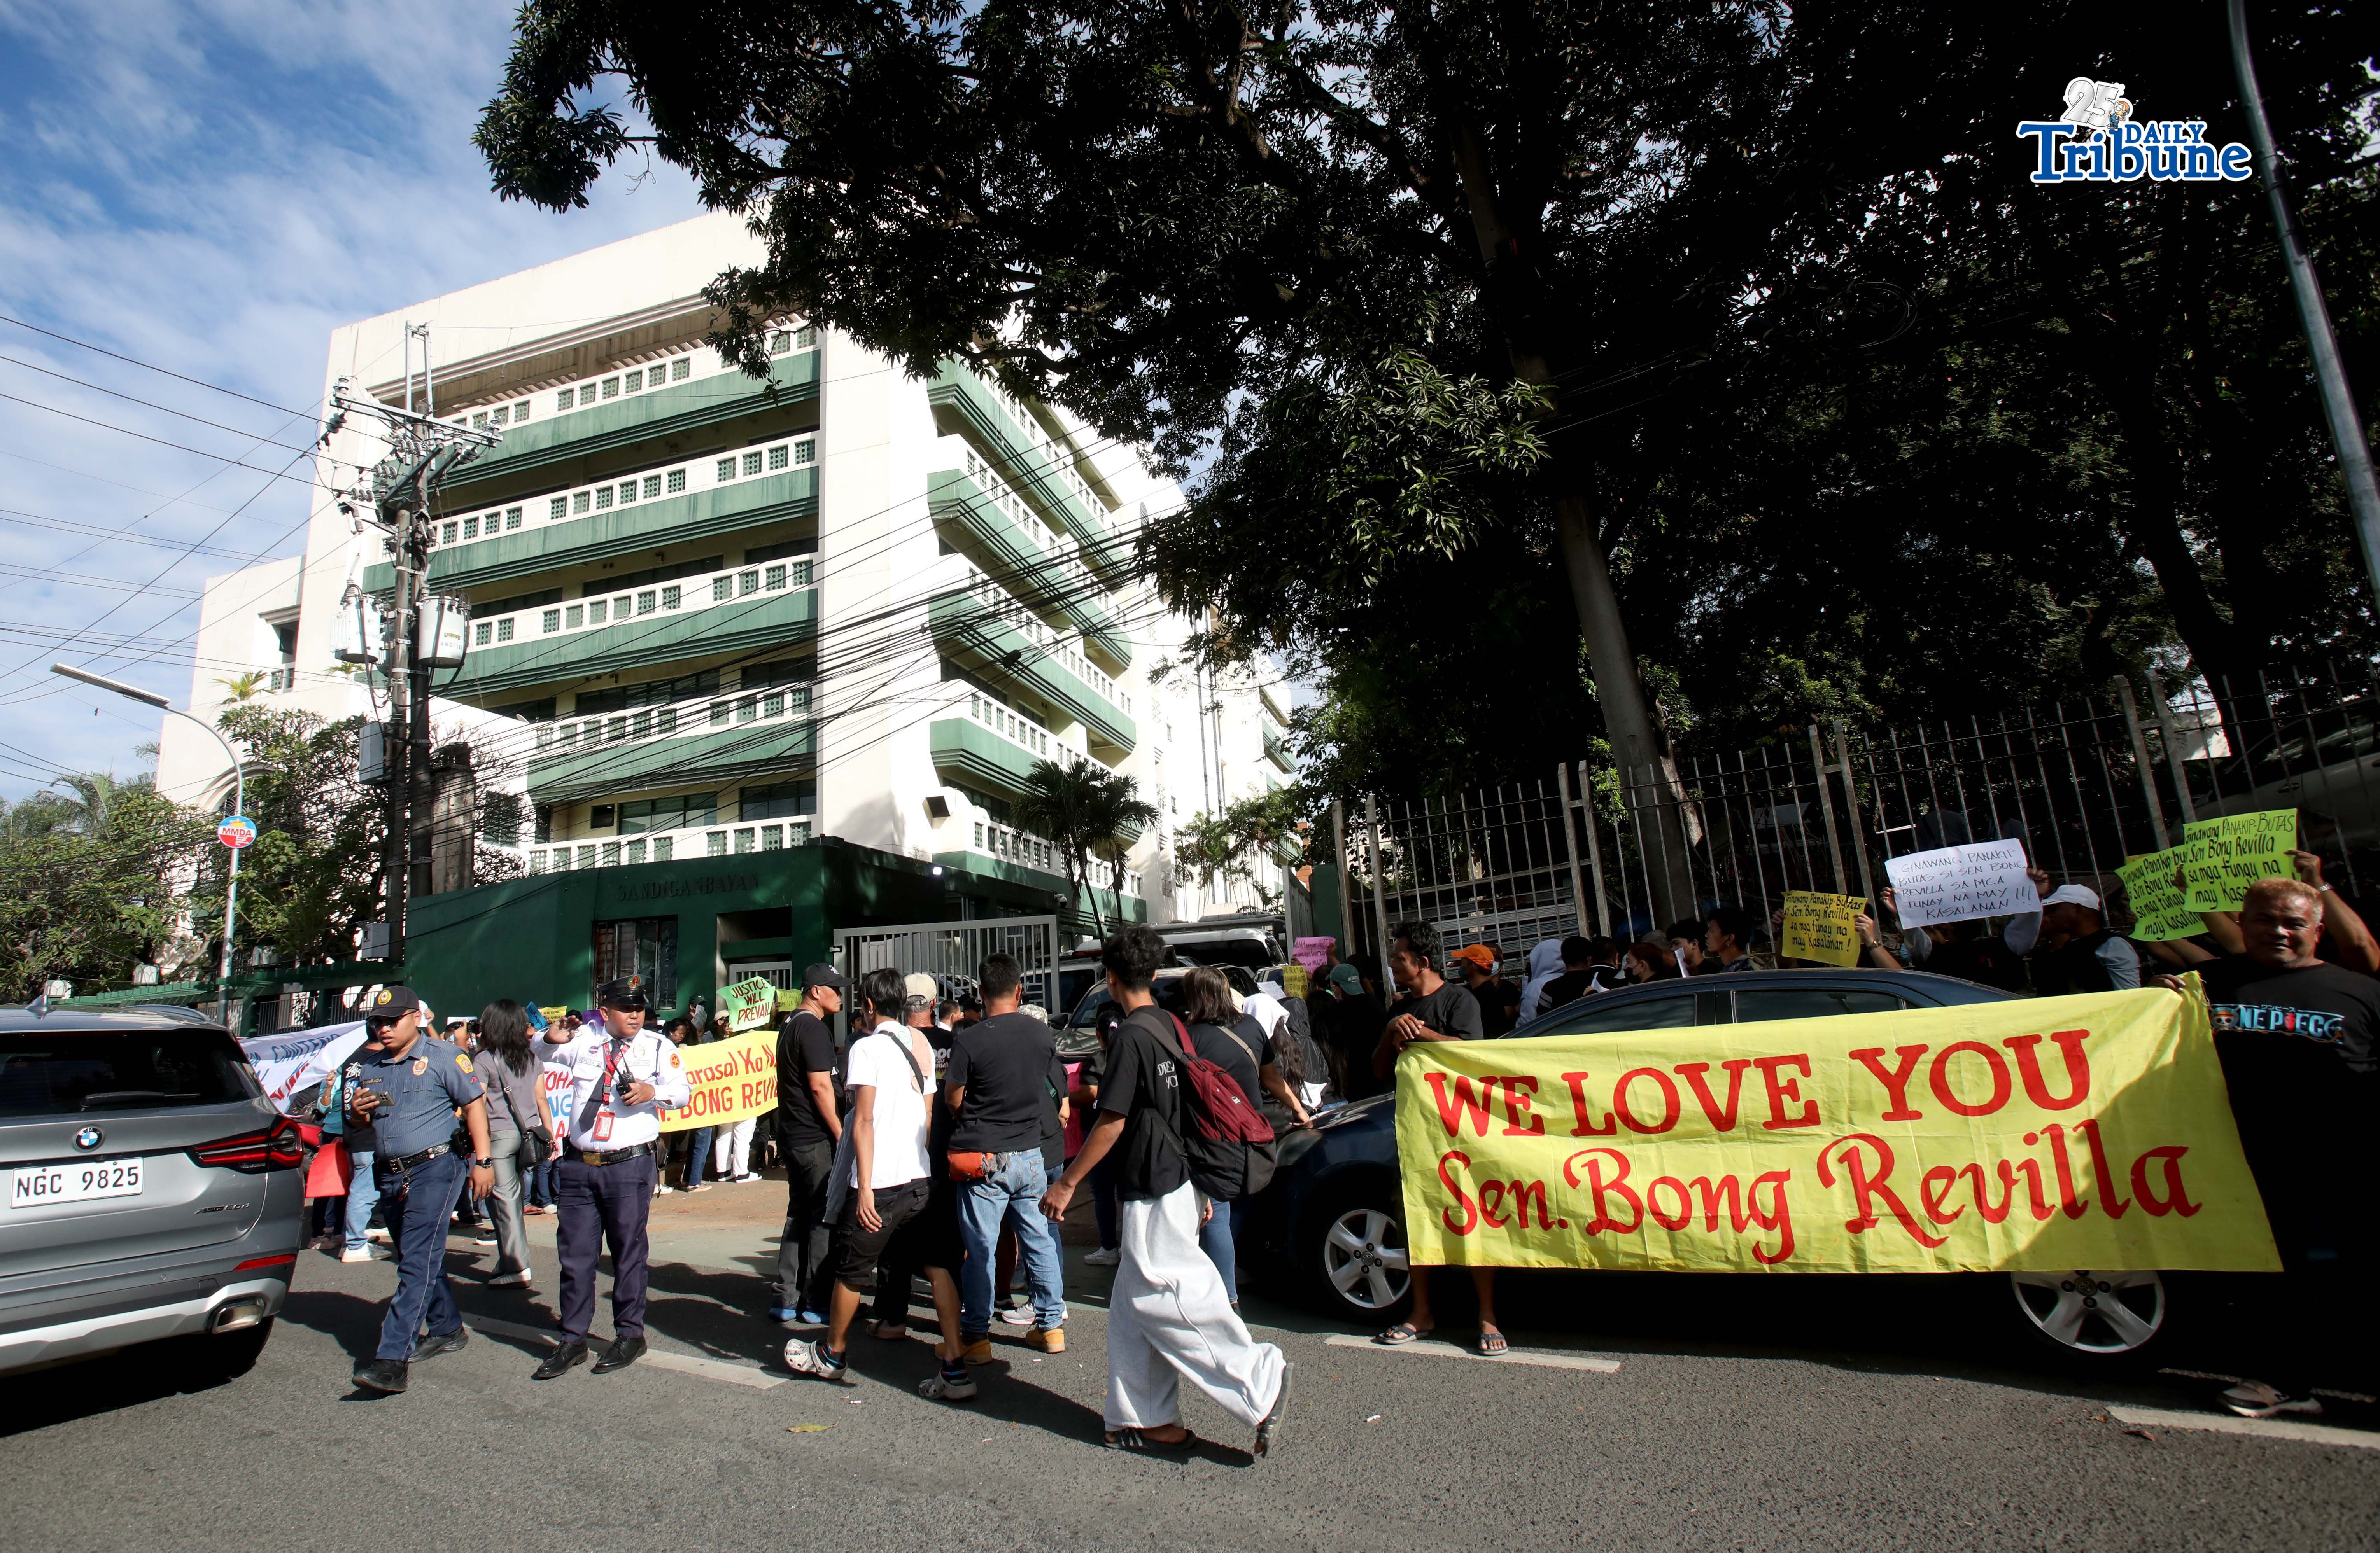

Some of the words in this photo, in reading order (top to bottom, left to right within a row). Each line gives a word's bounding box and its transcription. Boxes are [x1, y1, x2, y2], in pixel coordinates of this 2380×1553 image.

[222, 827, 252, 836] MMDA
[2185, 825, 2219, 844] Ginawang
[2222, 813, 2295, 836] PANAKIP-BUTAS
[2189, 844, 2204, 863] Sen
[2208, 839, 2232, 863] Bong
[2236, 834, 2275, 856] Revilla
[1902, 857, 1961, 873] GINAWANG
[1967, 849, 2016, 863] PANAKIP
[2188, 869, 2199, 883] sa
[2198, 864, 2221, 884] mga
[2222, 856, 2259, 880] tunay
[2262, 859, 2281, 874] na
[1898, 874, 1934, 887] BUTAS
[1940, 870, 1953, 879] SI
[1990, 860, 2026, 872] BONG
[616, 872, 760, 901] SANDIGANBAYAN
[1901, 884, 1944, 897] REVILLA
[1951, 880, 1969, 890] SA
[1974, 875, 2005, 888] MGA
[2144, 877, 2165, 897] Bong
[1786, 893, 1808, 907] Ginawang
[1906, 897, 1942, 908] TUNAY
[1954, 892, 1969, 902] NA
[1977, 887, 2007, 899] MAY
[2195, 889, 2218, 910] may
[1784, 906, 1789, 915] si
[1805, 904, 1820, 921] Bong
[1823, 906, 1849, 921] Revilla
[1926, 898, 2009, 920] KASALANAN
[2135, 906, 2146, 918] sa
[2144, 900, 2160, 918] mga
[1790, 922, 1797, 930] sa
[1799, 923, 1810, 934] mga
[1812, 920, 1832, 937] tunay
[1837, 926, 1847, 936] na
[2144, 920, 2166, 940] may
[1792, 936, 1805, 951] may
[1808, 934, 1843, 951] Kasalanan
[732, 979, 769, 999] JUSTICE
[744, 991, 765, 1006] WILL
[737, 1002, 771, 1025] PREVAIL
[1425, 1072, 1544, 1137] WE
[1561, 1054, 1821, 1136] LOVE
[1849, 1030, 2089, 1122] YOU
[17, 1173, 62, 1198] NGC
[82, 1166, 139, 1191] 9825
[1438, 1150, 1568, 1236] Sen.
[1564, 1148, 1794, 1264] Bong
[1818, 1119, 2201, 1248] Revilla
